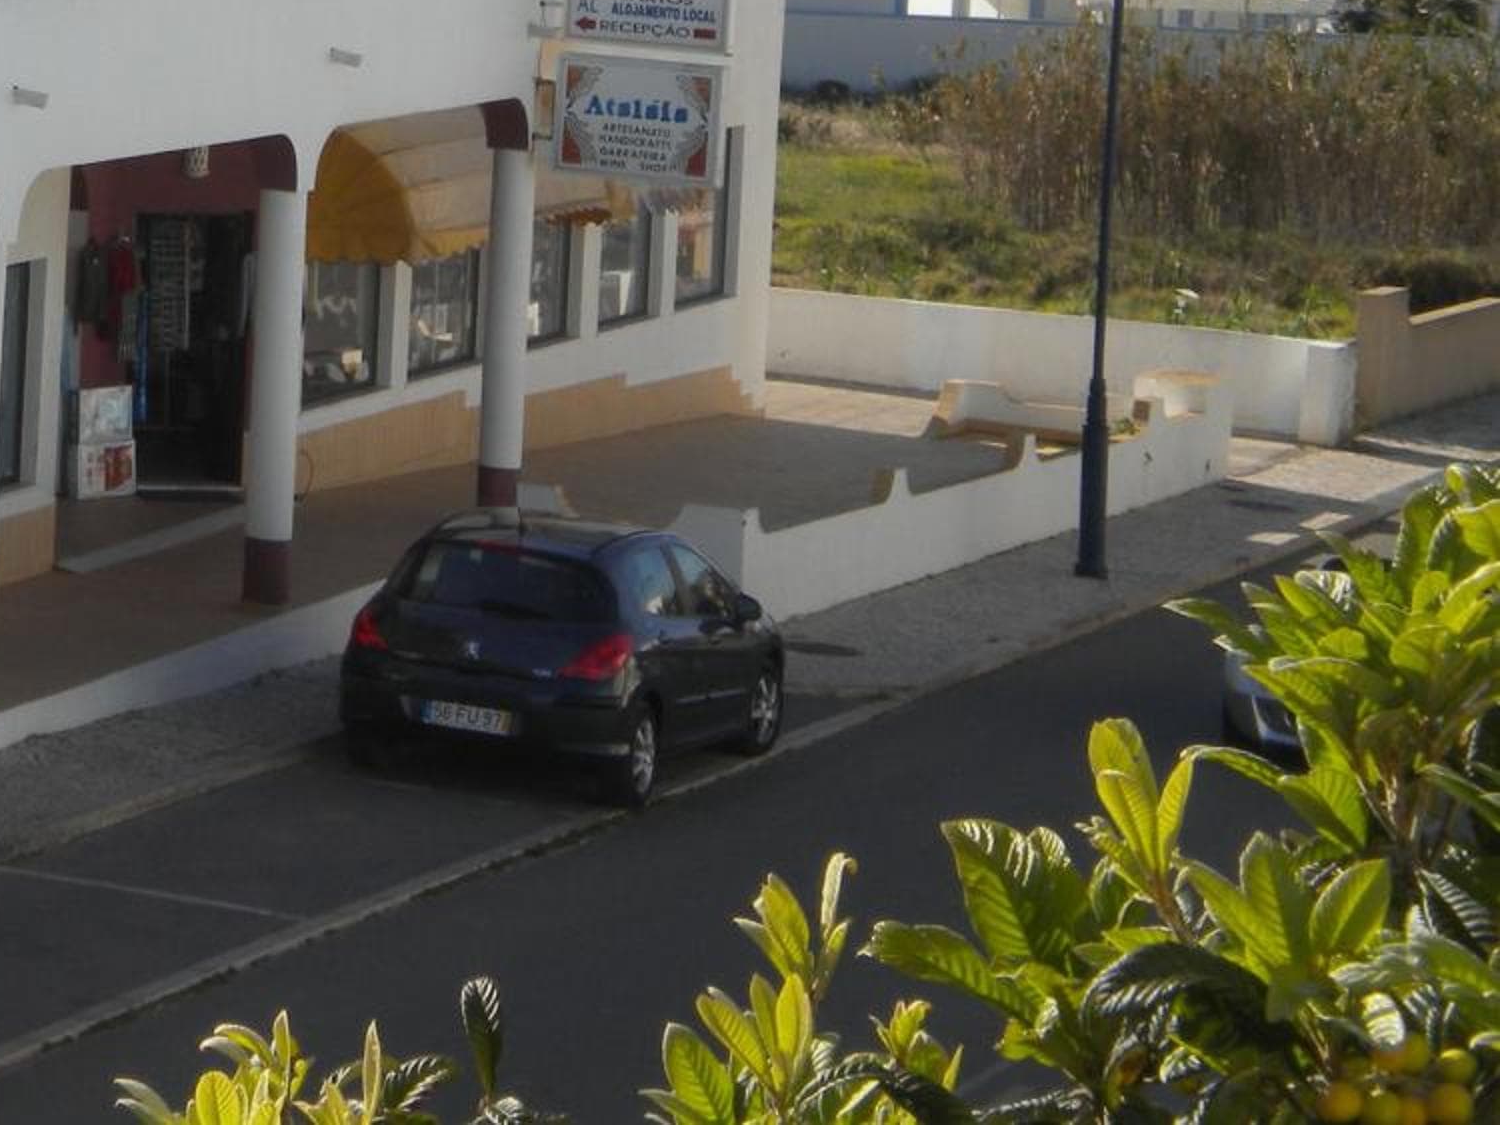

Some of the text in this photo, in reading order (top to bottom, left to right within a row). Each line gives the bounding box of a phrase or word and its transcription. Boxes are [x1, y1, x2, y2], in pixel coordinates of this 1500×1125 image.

[611, 2, 681, 20] ALOJAMENTO
[682, 8, 717, 23] LOCAL
[599, 19, 692, 39] RECEPÇÃO
